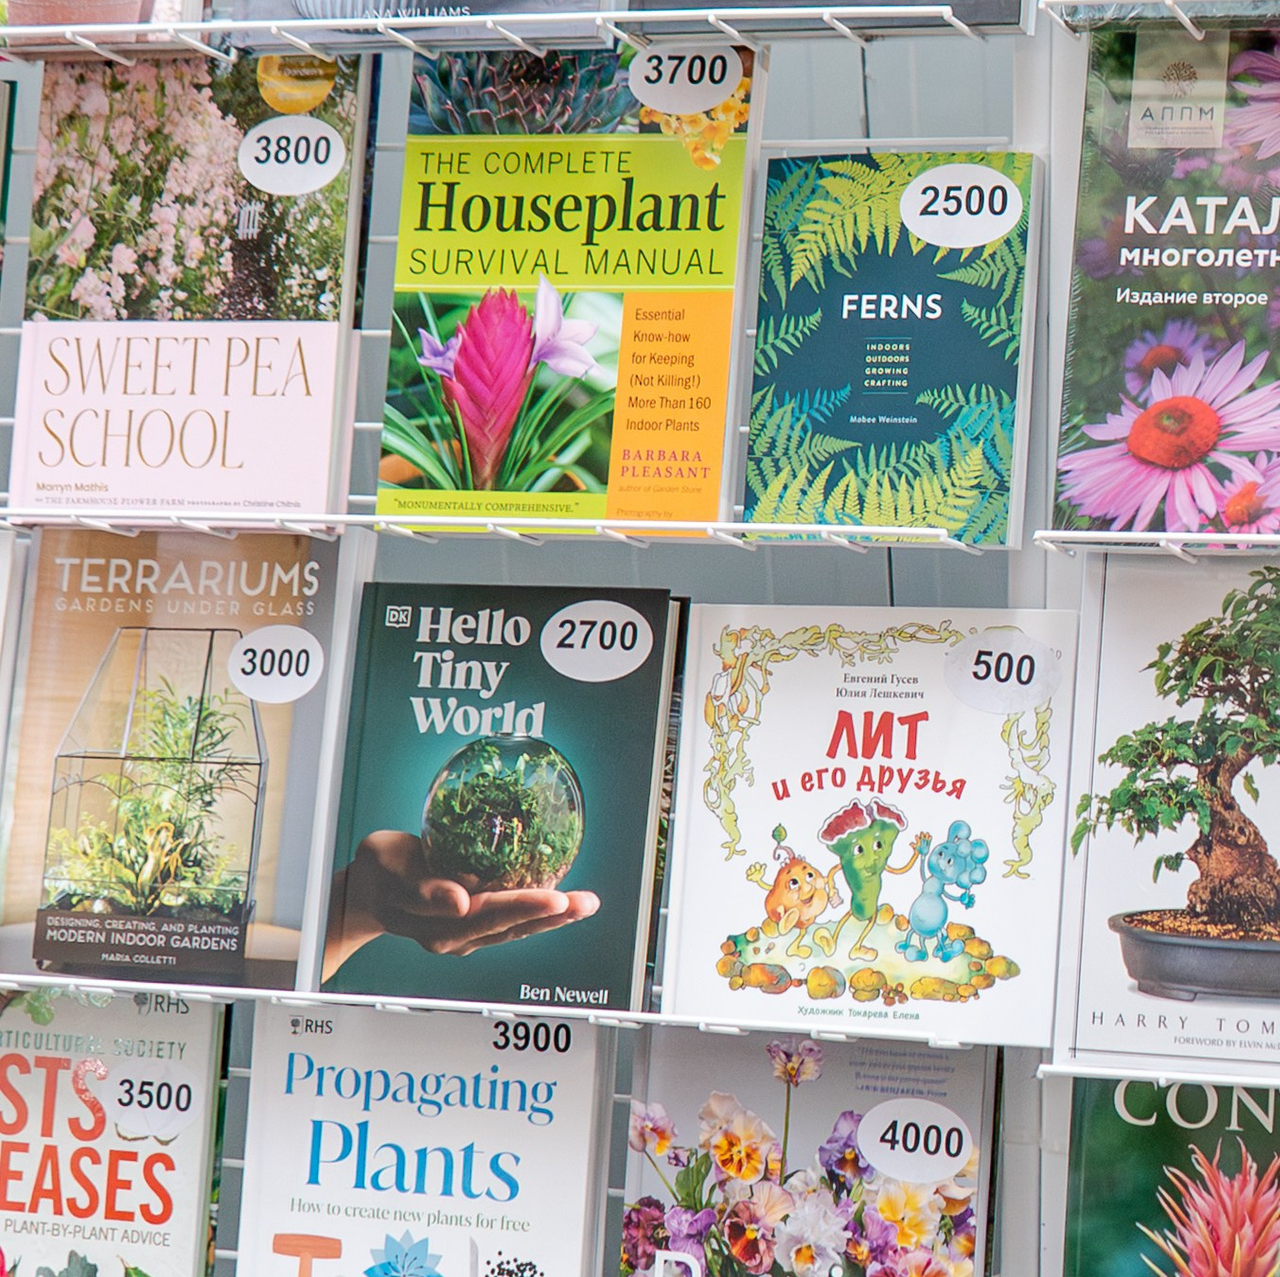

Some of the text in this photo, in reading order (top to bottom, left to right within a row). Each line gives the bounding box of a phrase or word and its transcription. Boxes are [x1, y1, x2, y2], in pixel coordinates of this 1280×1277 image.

[644, 55, 728, 87] 3700
[254, 135, 331, 164] 3800
[421, 151, 632, 176] THE COMPLETE
[413, 178, 726, 247] Houseplant
[920, 185, 1008, 217] 2500
[408, 248, 724, 277] SURVIVAL MANUAL
[842, 294, 943, 320] FERNS
[1116, 288, 1268, 306] Издание второе
[44, 336, 313, 398] SWEET PEA
[38, 408, 244, 470] SCHOOL
[622, 448, 702, 462] BARBARA
[621, 465, 711, 479] PLEASANT
[55, 557, 320, 597] TERRARIUMS
[417, 607, 531, 647] Hello
[556, 620, 639, 651] 2700
[240, 647, 311, 676] 3000
[414, 651, 509, 700] Tiny
[972, 650, 1036, 685] 500
[843, 673, 919, 686] Евгений Гусев
[410, 697, 546, 738] World
[826, 709, 929, 760] ЛИТ
[772, 765, 967, 801] и его друзья
[519, 983, 609, 1004] Ben Newell
[492, 1021, 572, 1053] 3900
[117, 1079, 193, 1112] 3500
[284, 1052, 558, 1126] Propagating
[879, 1120, 963, 1157] 4000
[306, 1120, 522, 1203] Plants
